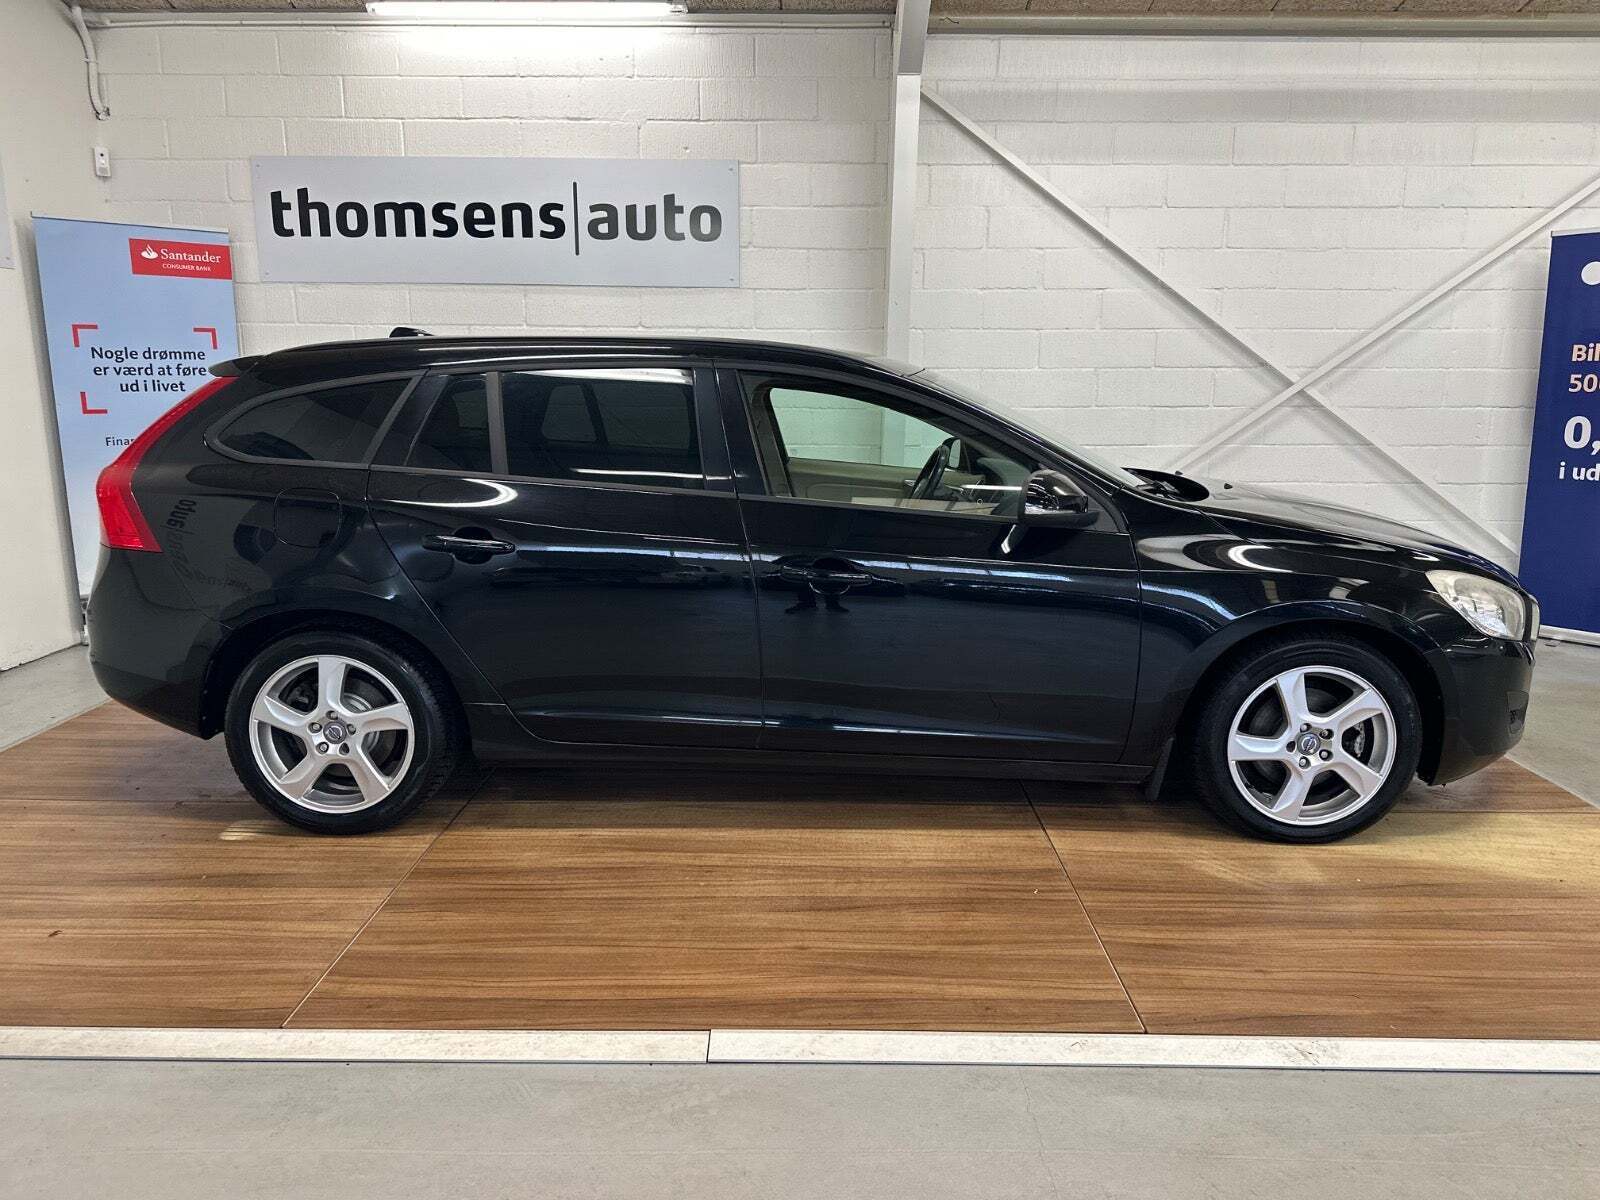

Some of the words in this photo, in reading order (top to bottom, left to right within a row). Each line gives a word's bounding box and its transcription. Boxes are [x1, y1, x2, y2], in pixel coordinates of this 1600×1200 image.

[160, 248, 221, 263] Santander
[162, 263, 196, 271] CONSUMER
[91, 347, 138, 363] Nogle
[142, 347, 206, 360] drømme
[93, 366, 110, 375] er
[113, 363, 153, 376] værd
[157, 365, 172, 376] at
[175, 363, 207, 376] føre
[120, 380, 140, 392] ud
[143, 380, 148, 392] i
[152, 380, 186, 392] livet
[1568, 373, 1600, 393] 50
[1559, 461, 1566, 480] i
